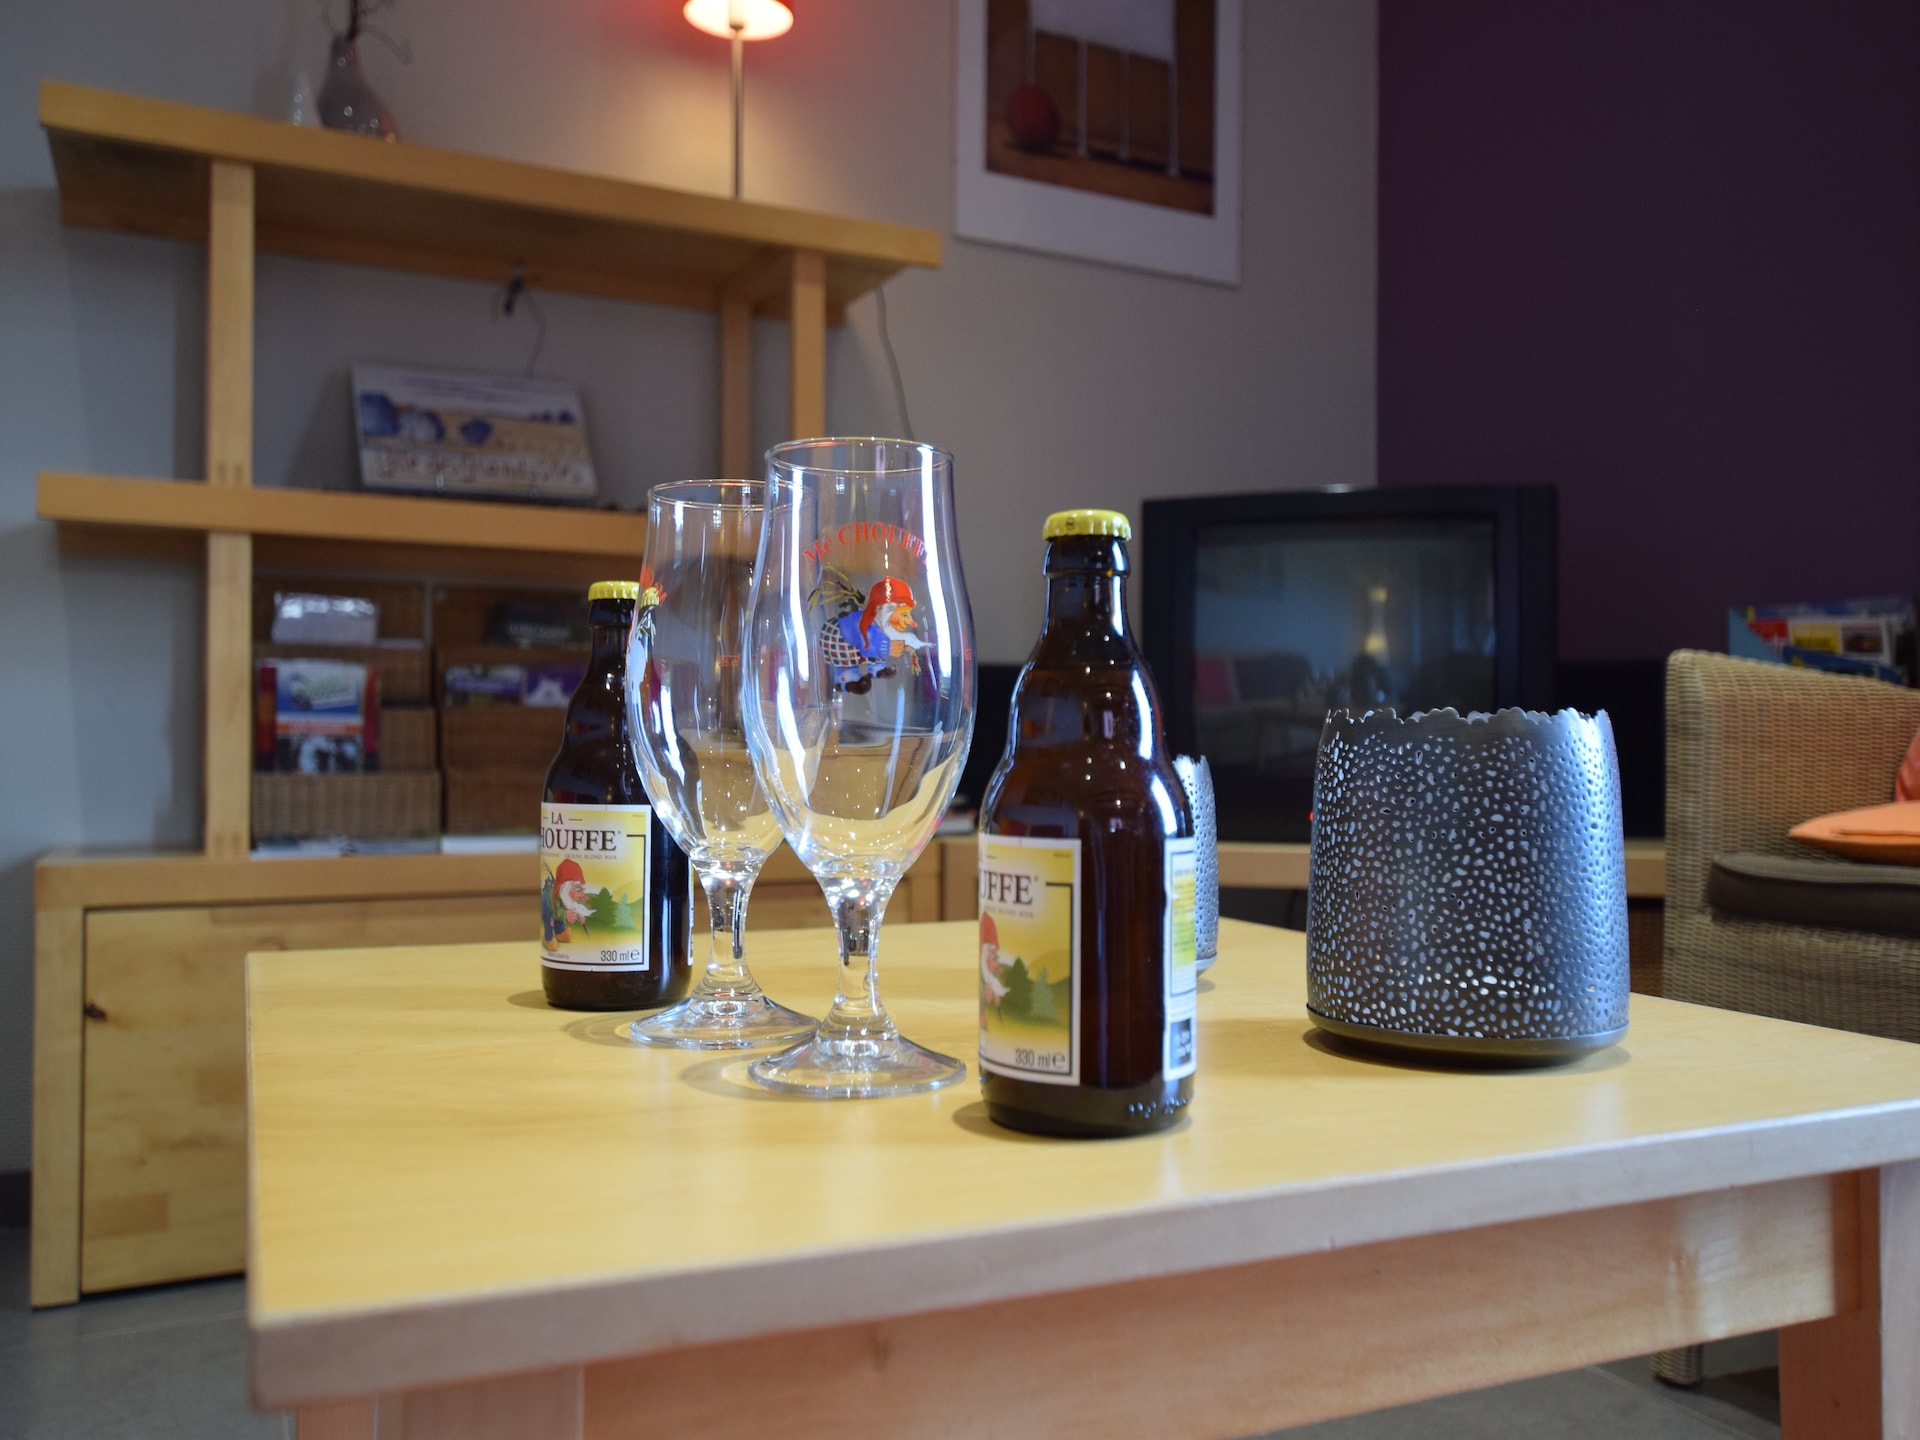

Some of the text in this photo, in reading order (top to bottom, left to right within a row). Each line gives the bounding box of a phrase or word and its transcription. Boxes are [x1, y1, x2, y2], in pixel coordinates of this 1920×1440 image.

[803, 538, 832, 568] Mc
[551, 811, 564, 825] LA
[540, 826, 617, 851] HOUFFE
[980, 869, 1032, 906] UFFE
[600, 949, 618, 962] 330
[1014, 1046, 1035, 1065] 330
